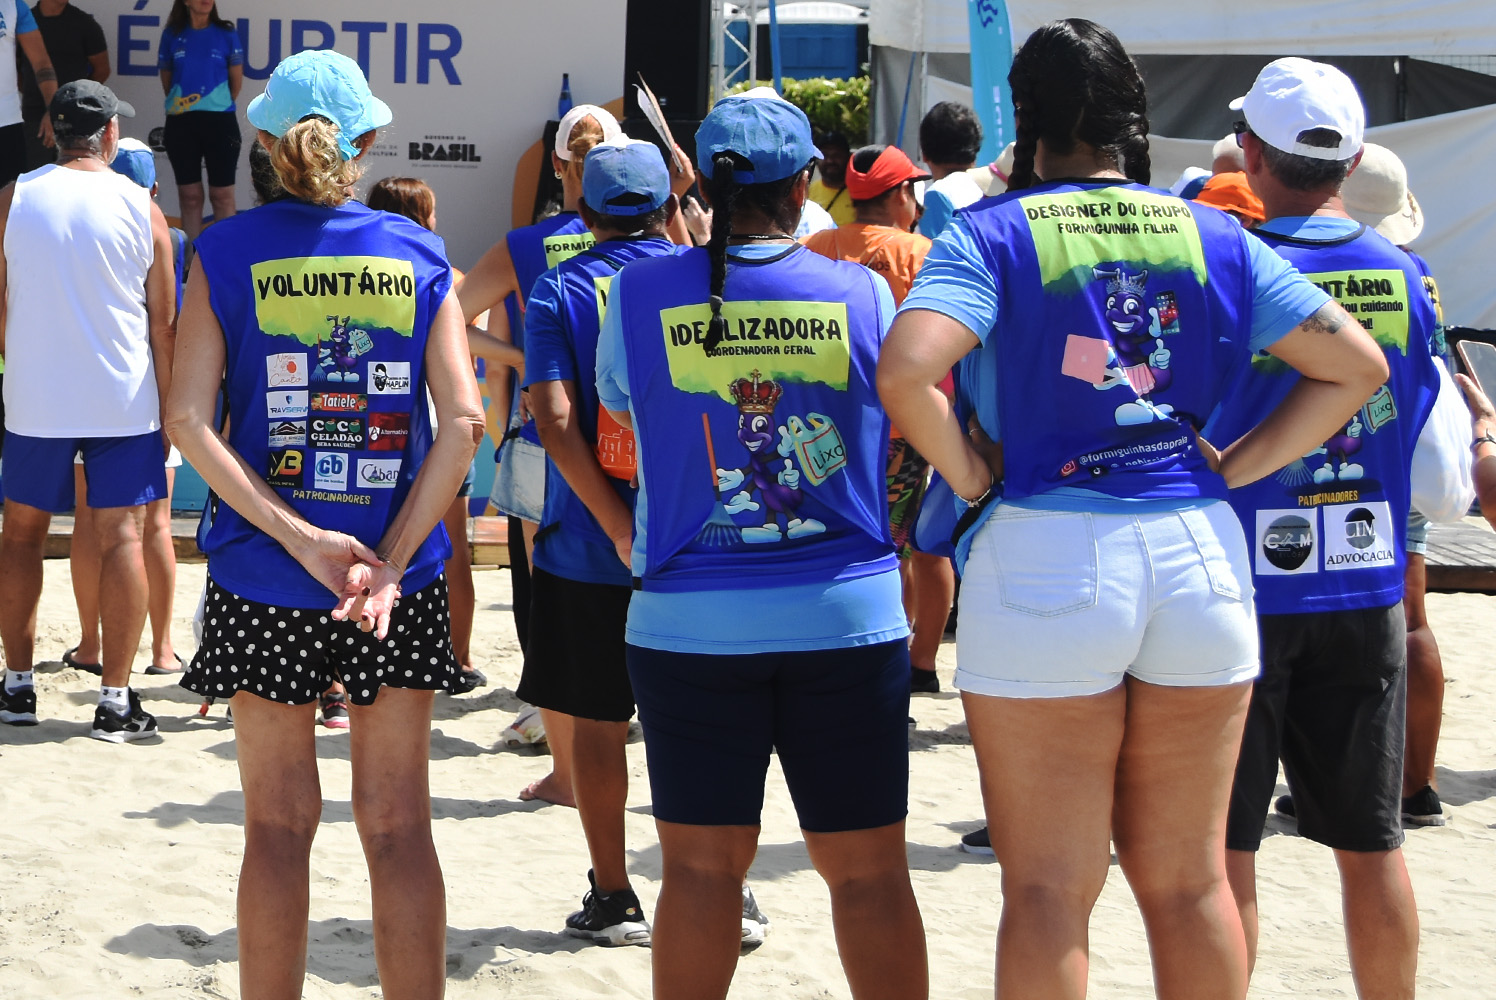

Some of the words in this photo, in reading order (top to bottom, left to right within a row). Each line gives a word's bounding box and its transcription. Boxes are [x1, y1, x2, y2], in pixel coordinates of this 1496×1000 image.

[116, 0, 160, 77] É
[236, 17, 463, 86] URTIR
[408, 141, 482, 162] BRASIL
[1025, 202, 1112, 221] DESIGNER
[1117, 201, 1137, 217] DO
[1141, 202, 1191, 219] GRUPO
[1057, 222, 1140, 235] FORMIGUINHA
[1143, 223, 1179, 234] FILHA
[257, 265, 413, 301] VOLUNTÁRIO
[1360, 300, 1404, 312] cuidando
[669, 317, 842, 347] IDELIZADORA
[784, 345, 817, 356] GERAL
[322, 394, 356, 408] Tatiele
[310, 432, 363, 443] GELADÃO
[813, 444, 845, 470] Lixo
[1078, 435, 1189, 466] @formiguinhasdapraia
[292, 489, 371, 505] PATROCINADORES
[1326, 550, 1393, 565] ADVOCACIA
